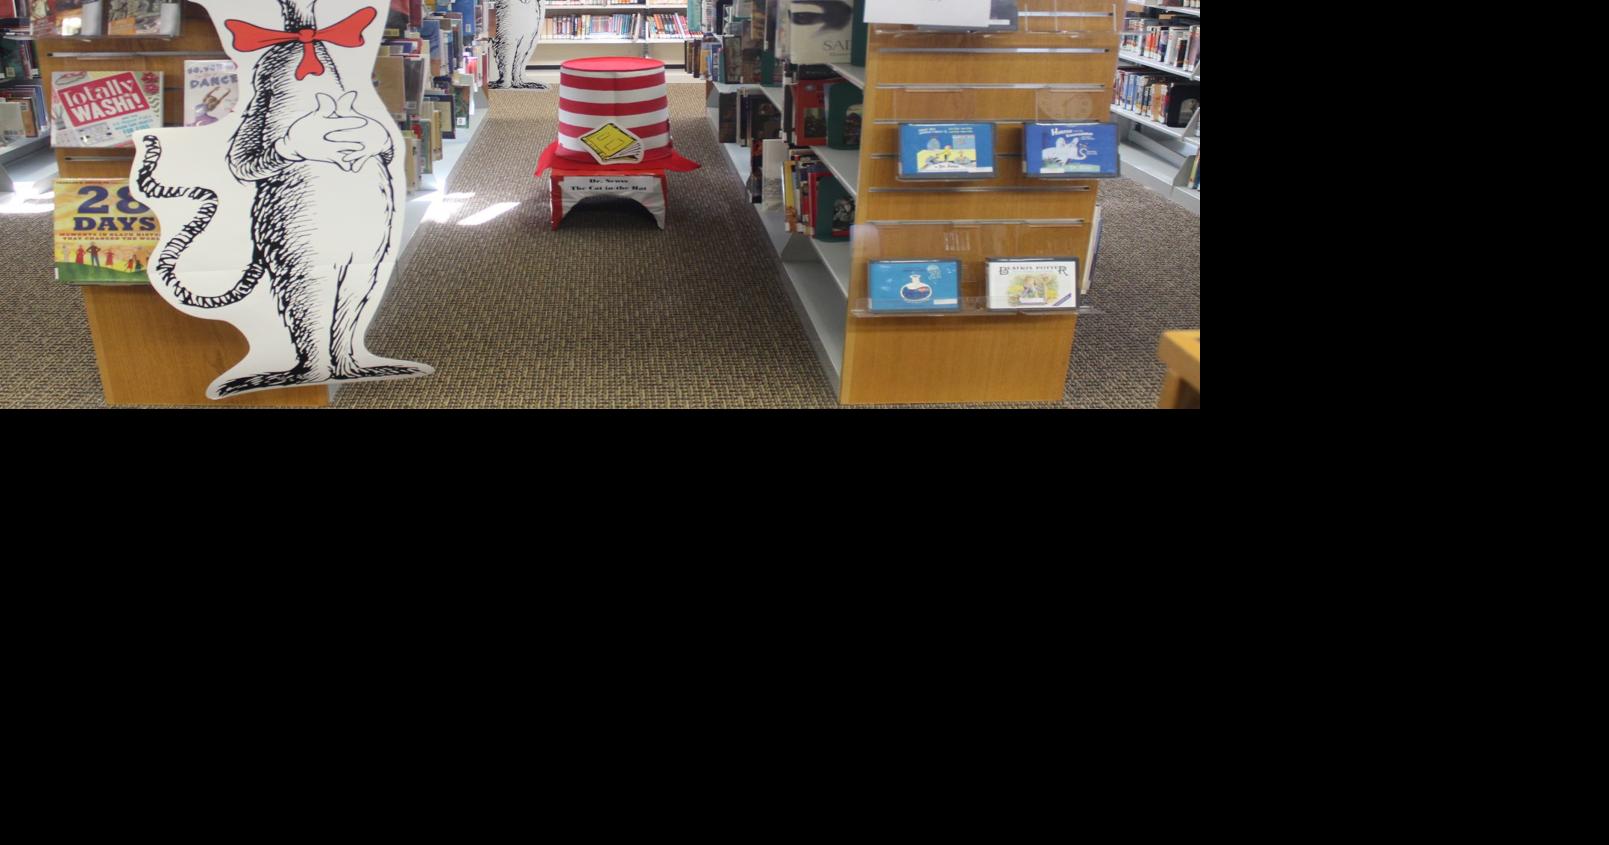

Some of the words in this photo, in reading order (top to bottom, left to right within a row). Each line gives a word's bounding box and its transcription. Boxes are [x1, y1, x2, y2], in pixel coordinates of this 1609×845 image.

[63, 79, 134, 107] Totally
[77, 185, 150, 214] 28
[73, 217, 156, 231] DAYS
